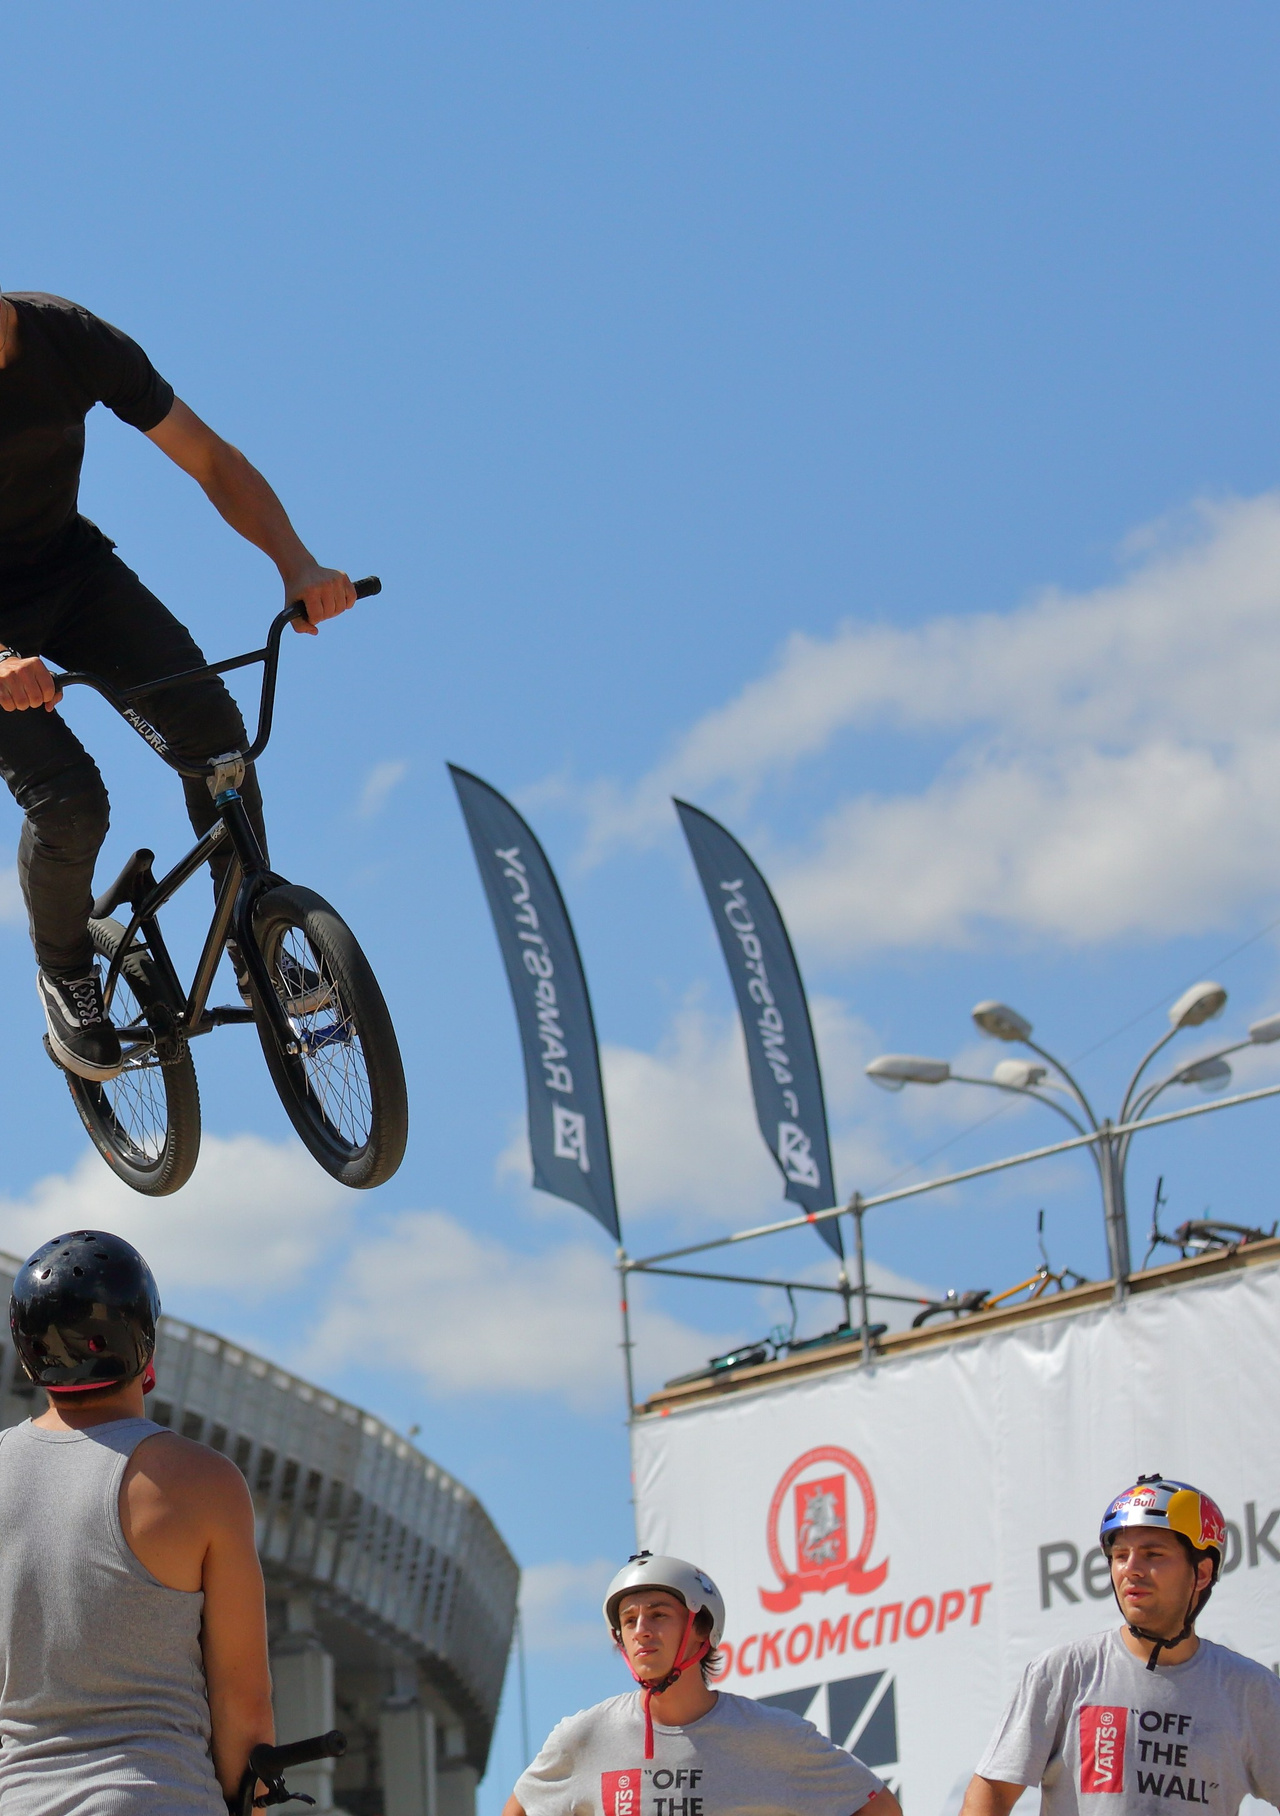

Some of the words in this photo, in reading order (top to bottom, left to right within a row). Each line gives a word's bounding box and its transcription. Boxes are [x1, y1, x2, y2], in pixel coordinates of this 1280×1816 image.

[124, 708, 169, 755] FAILURE
[1133, 1498, 1156, 1508] Bull
[710, 1582, 992, 1683] ОСКОМСПОРТ
[1138, 1739, 1189, 1767] THE
[653, 1797, 704, 1816] THE
